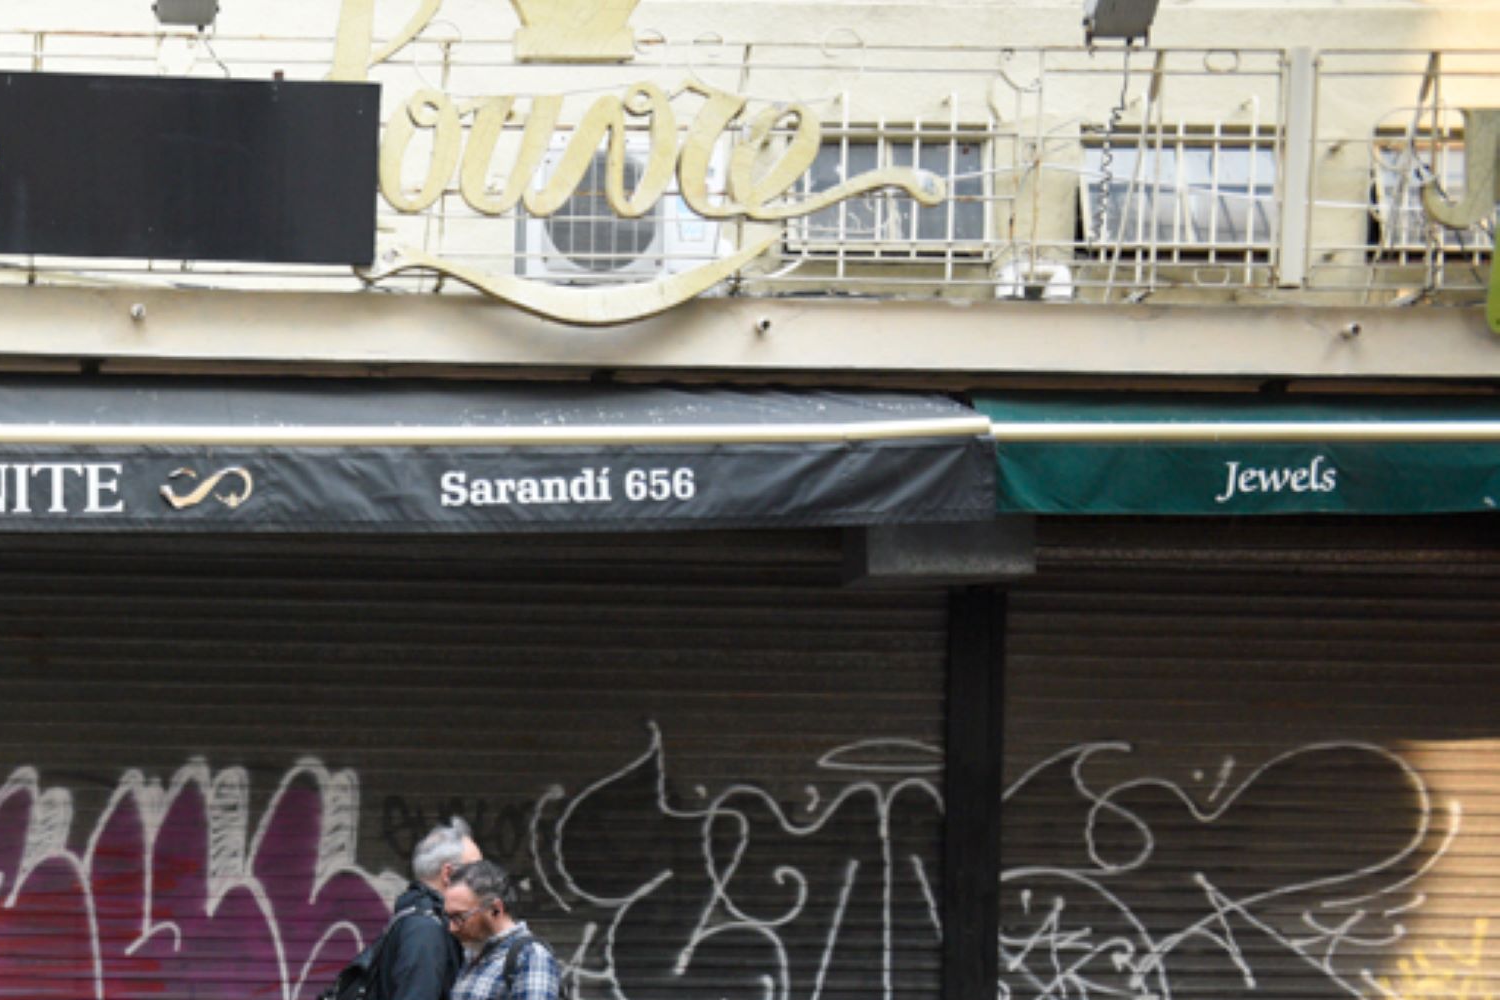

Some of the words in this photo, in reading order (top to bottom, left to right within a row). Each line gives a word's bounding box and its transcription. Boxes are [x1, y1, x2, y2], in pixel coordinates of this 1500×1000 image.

[440, 467, 612, 506] Sarandí
[624, 467, 696, 501] 656
[1214, 455, 1338, 503] Jewels
